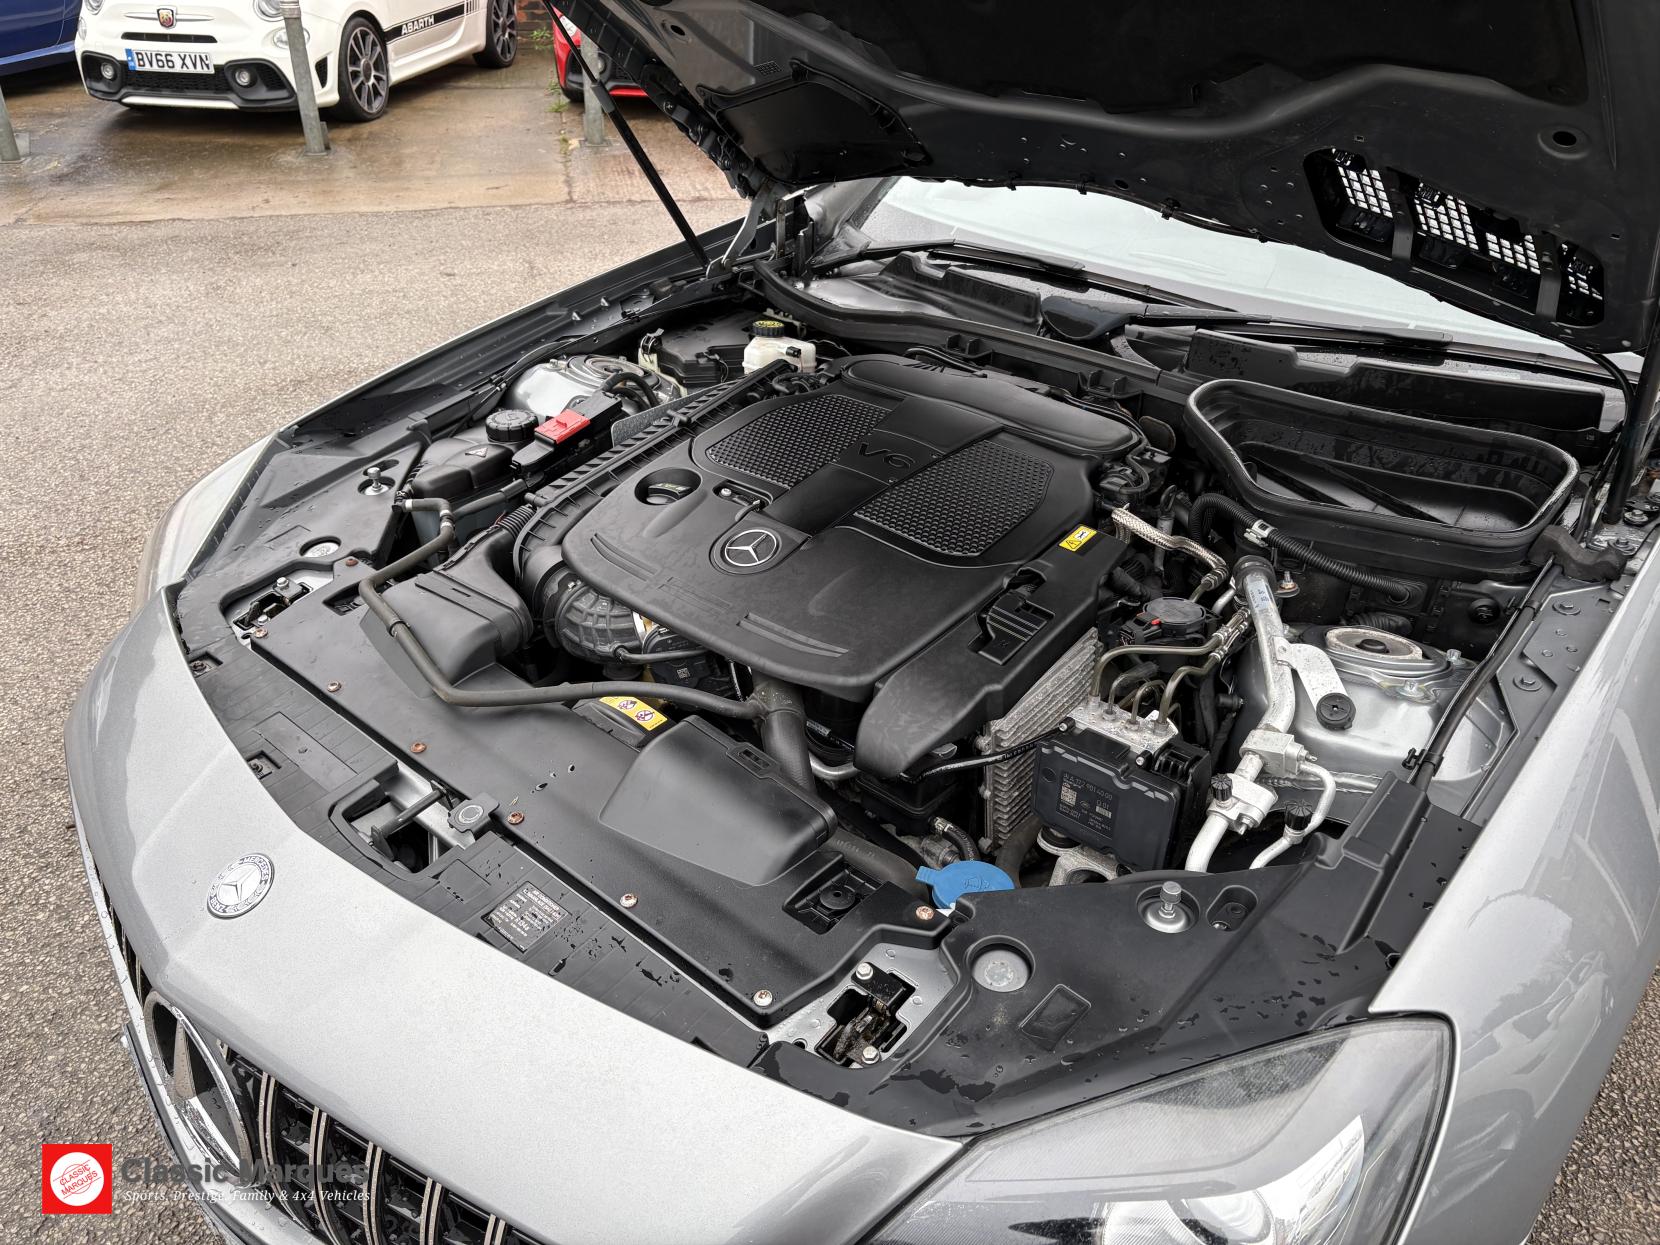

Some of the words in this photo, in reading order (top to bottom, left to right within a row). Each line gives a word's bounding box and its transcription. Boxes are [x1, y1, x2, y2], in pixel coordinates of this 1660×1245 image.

[401, 15, 435, 35] ABARTH
[135, 52, 175, 69] BV66
[178, 53, 210, 70] XVN
[859, 441, 916, 470] V6
